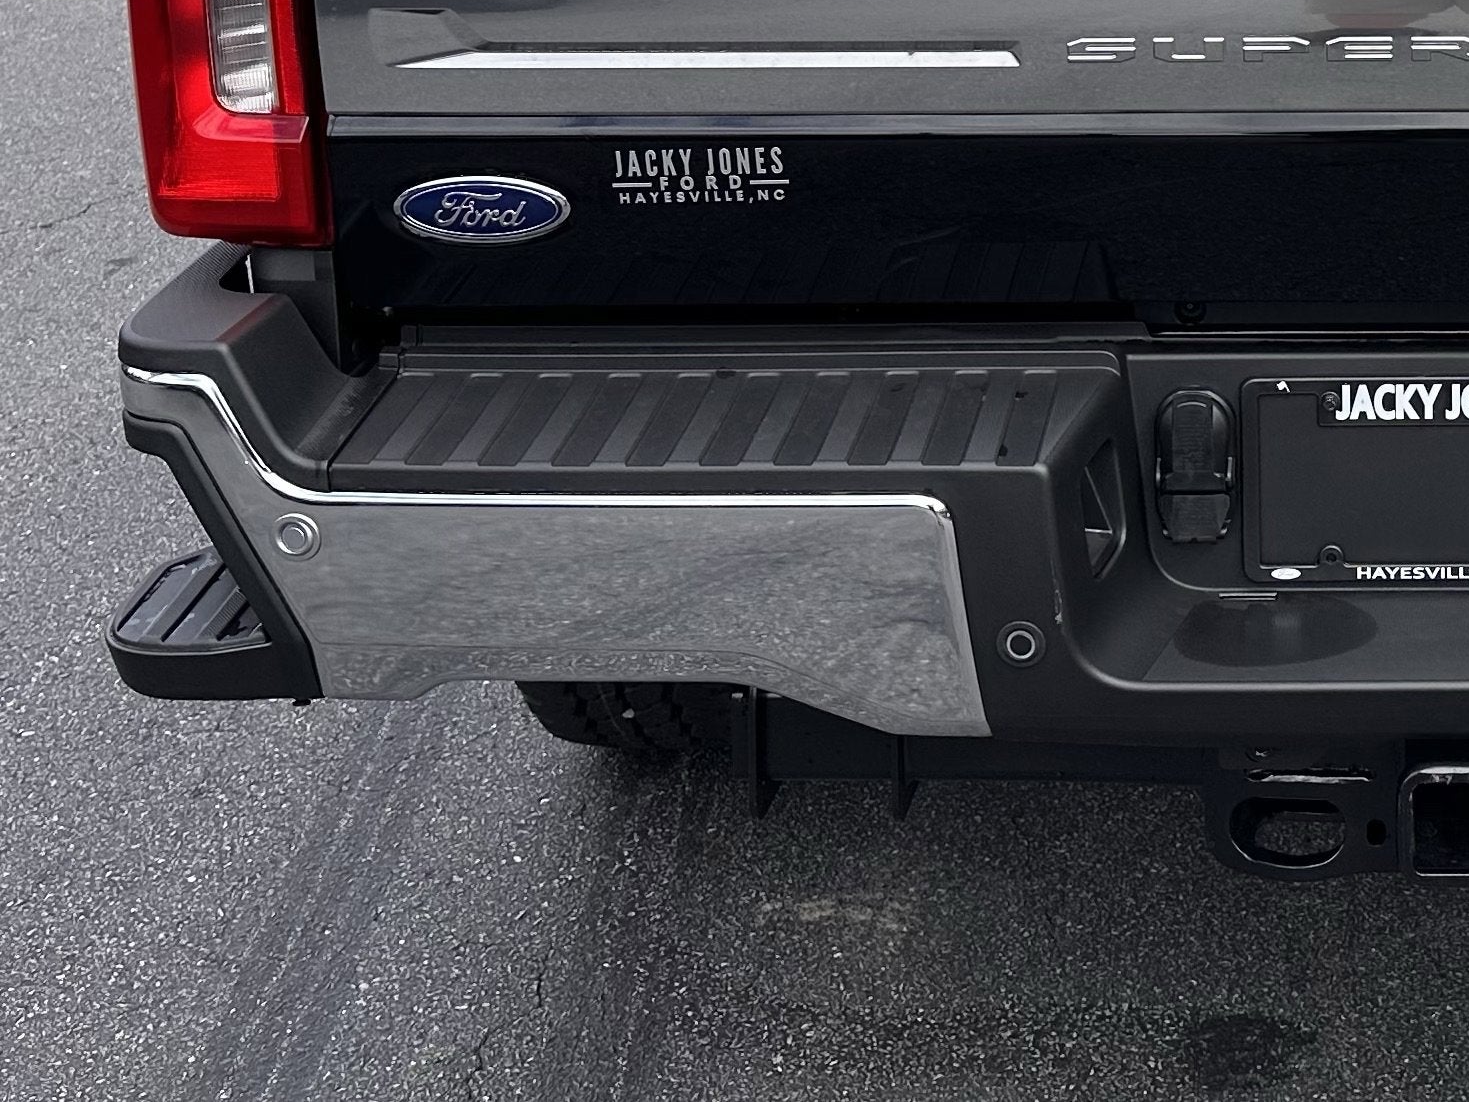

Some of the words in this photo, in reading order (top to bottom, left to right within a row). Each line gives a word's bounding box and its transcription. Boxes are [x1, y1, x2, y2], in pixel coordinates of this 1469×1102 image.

[614, 148, 692, 178] JACKY
[706, 146, 784, 176] JONES
[659, 174, 742, 191] FORD
[433, 190, 527, 230] Ford
[1335, 382, 1442, 421] JACKY
